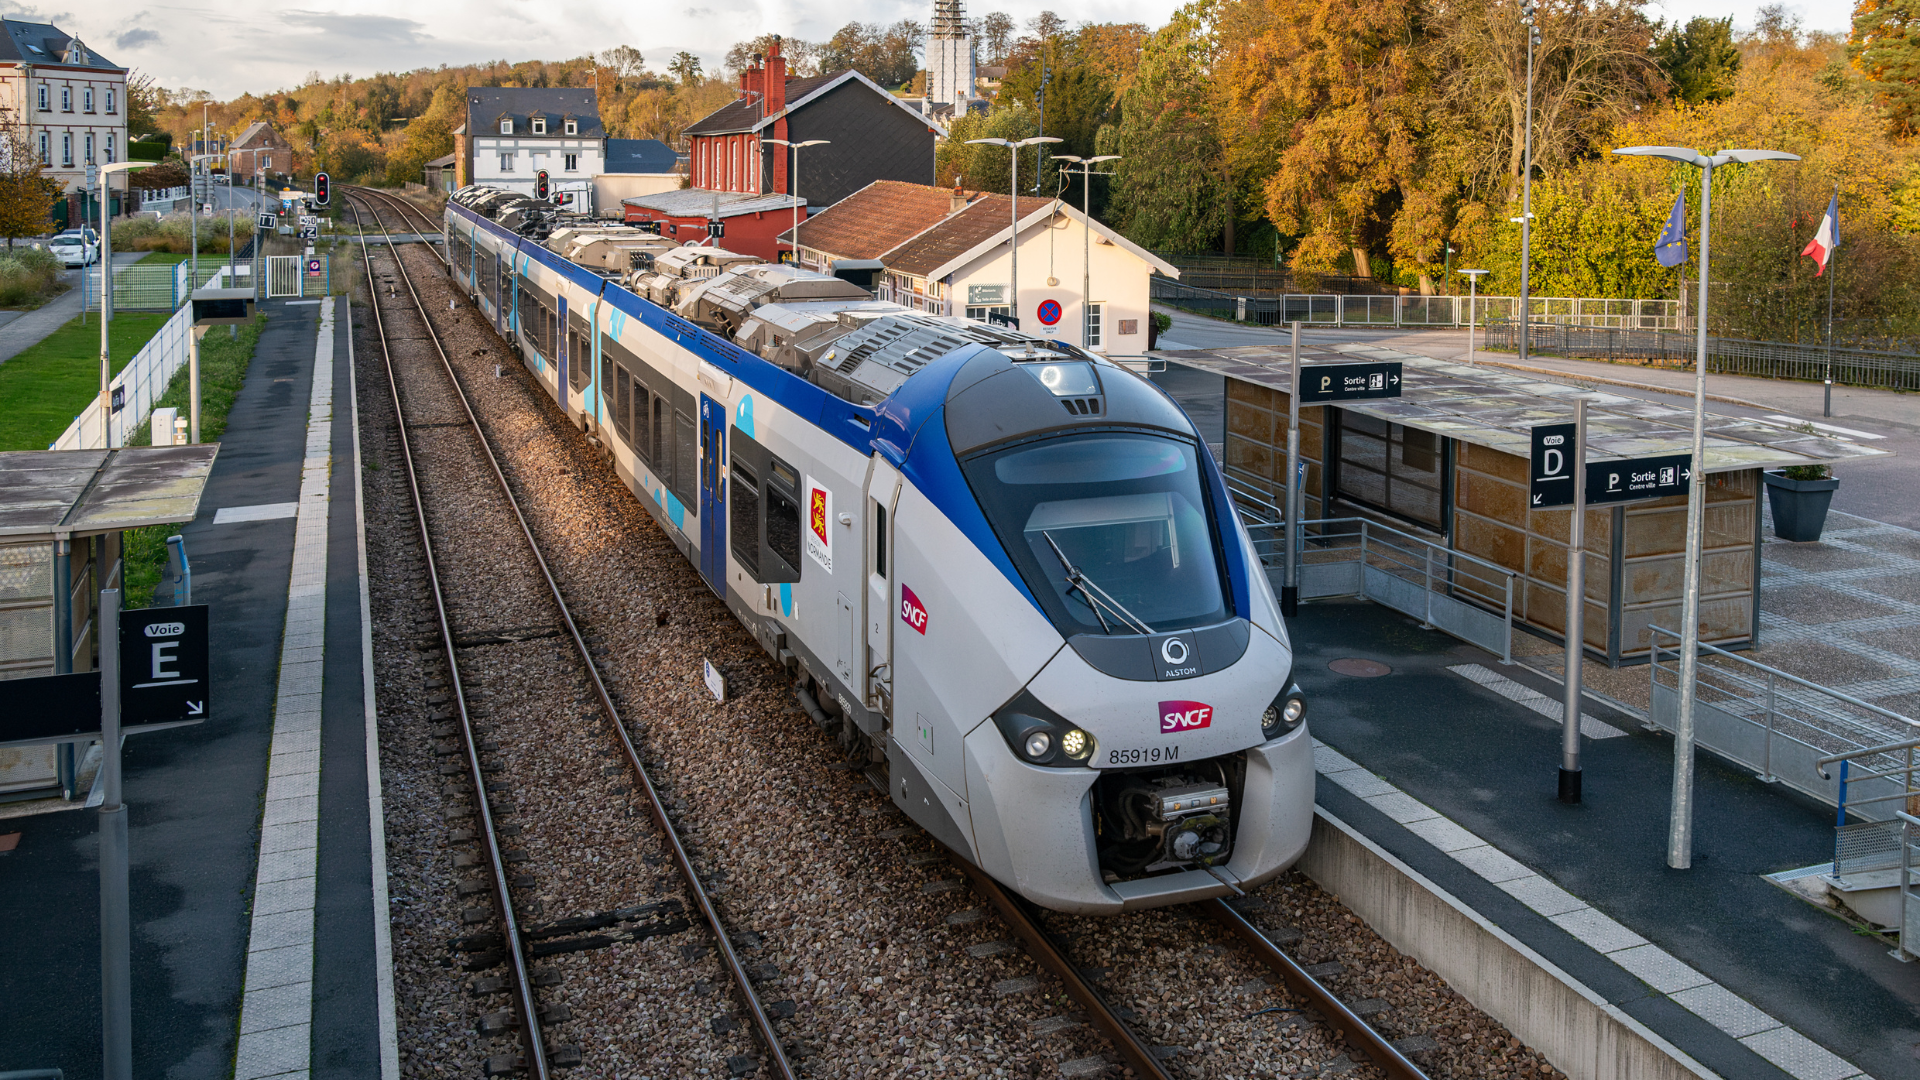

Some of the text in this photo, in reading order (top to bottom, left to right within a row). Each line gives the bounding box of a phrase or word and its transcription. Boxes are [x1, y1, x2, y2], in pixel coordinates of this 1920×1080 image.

[708, 224, 723, 235] TT
[1321, 376, 1366, 391] P Sortie
[1545, 436, 1562, 444] Voie
[1544, 449, 1564, 476] D
[1608, 471, 1656, 490] P Sortie
[1629, 483, 1646, 491] Centre
[806, 540, 832, 571] NORMANDIE
[902, 600, 927, 628] SNCF
[149, 624, 180, 635] Voie
[151, 641, 180, 679] E
[1165, 667, 1197, 678] ALSTOM
[1162, 707, 1210, 730] SNCF
[1109, 745, 1179, 764] 85919 M
